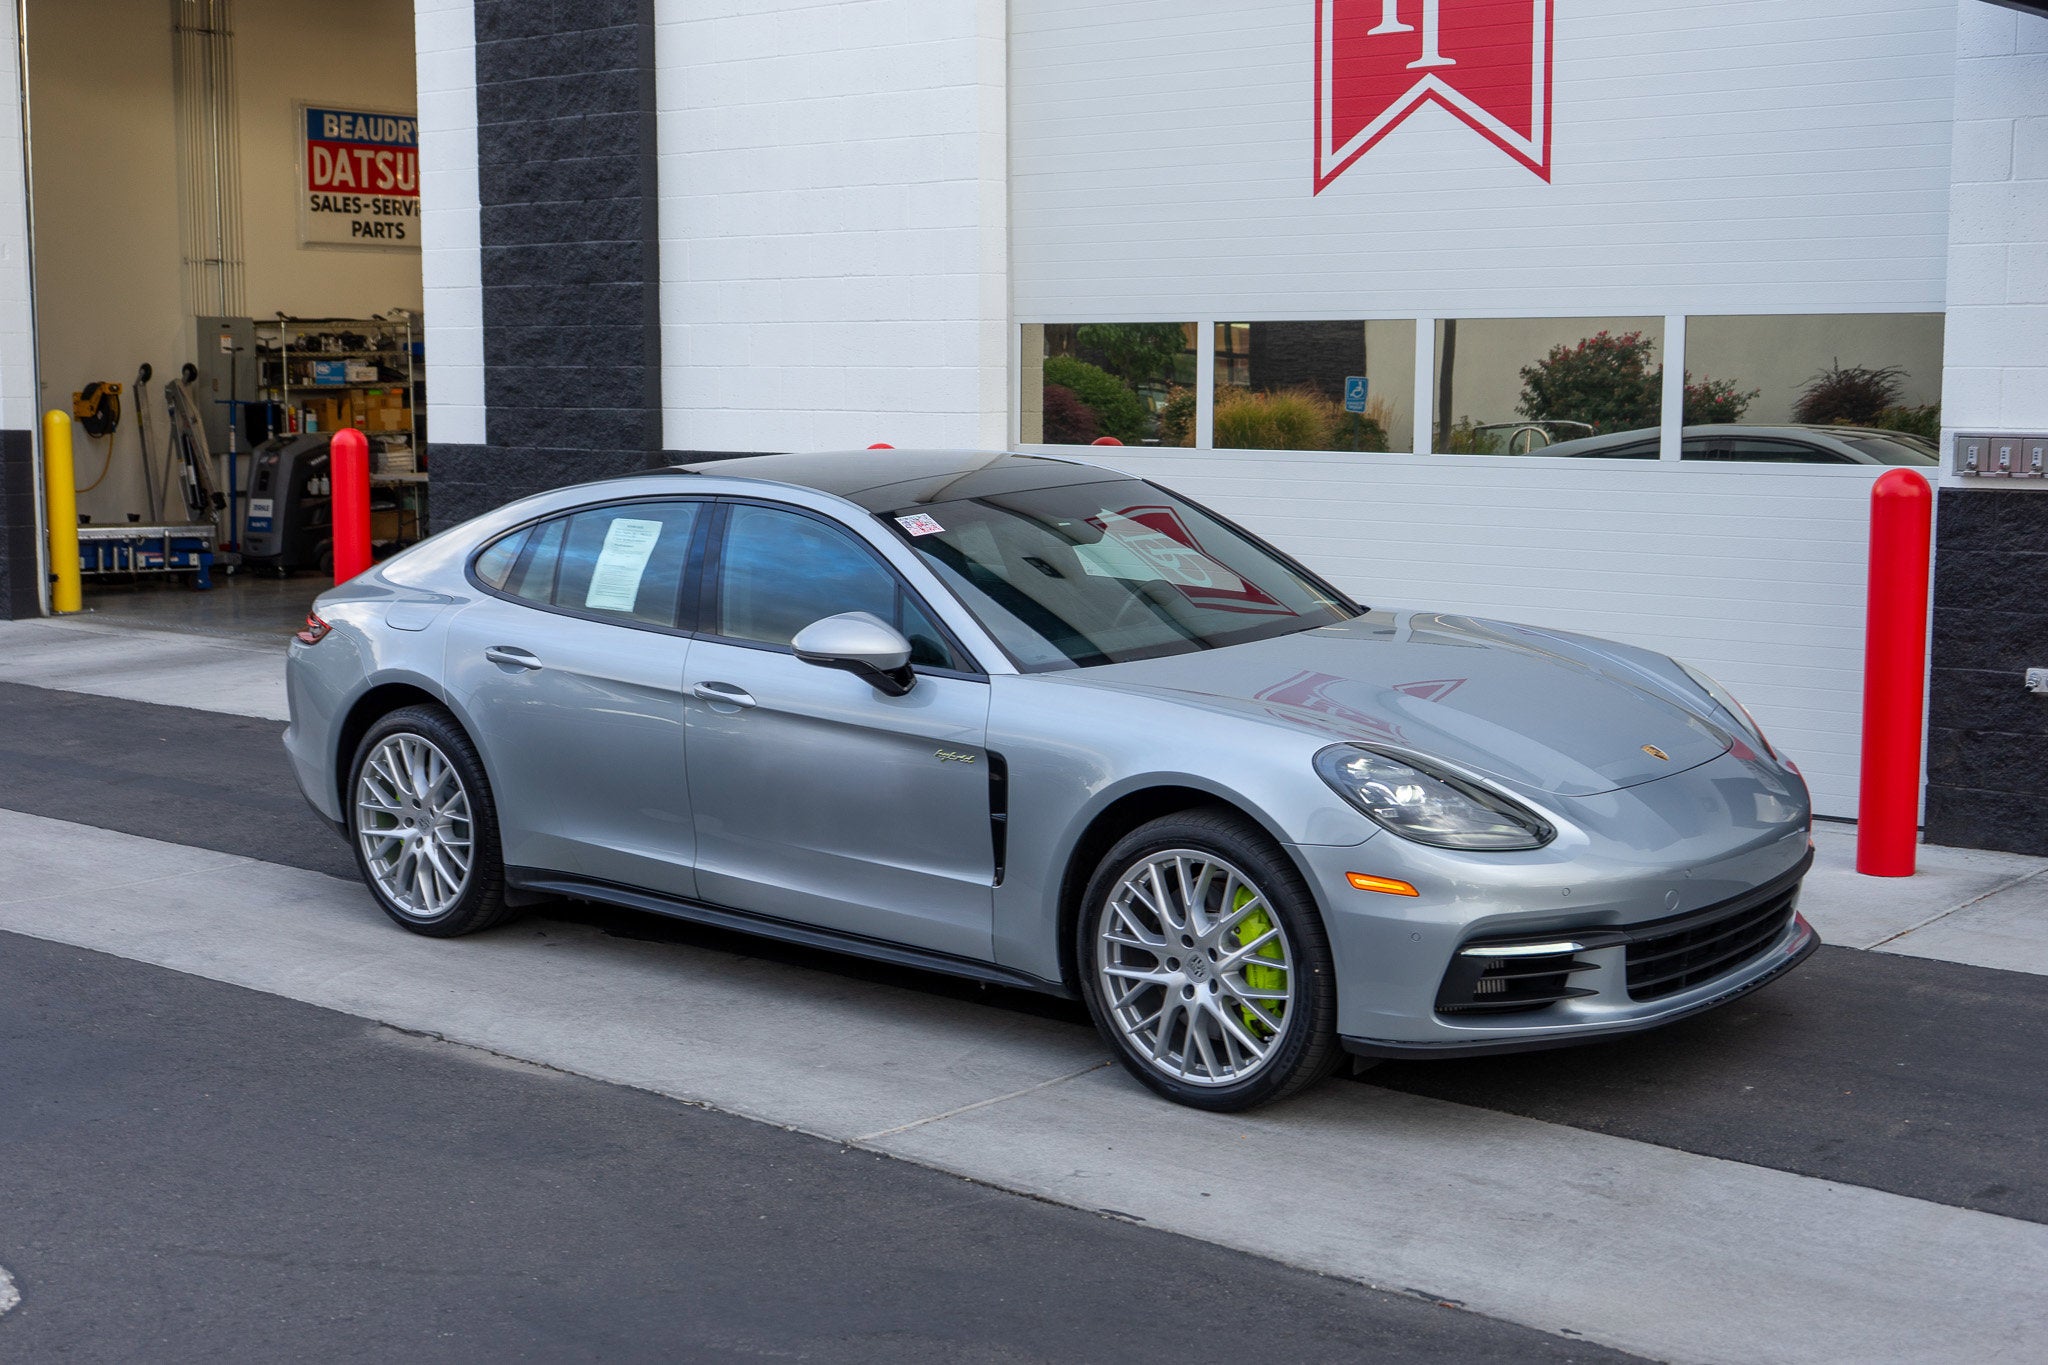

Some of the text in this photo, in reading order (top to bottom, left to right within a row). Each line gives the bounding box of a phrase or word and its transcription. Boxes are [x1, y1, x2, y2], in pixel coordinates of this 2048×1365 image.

[313, 146, 419, 191] DATSU
[310, 194, 420, 217] SALES-SERVI
[351, 220, 406, 239] PARTS
